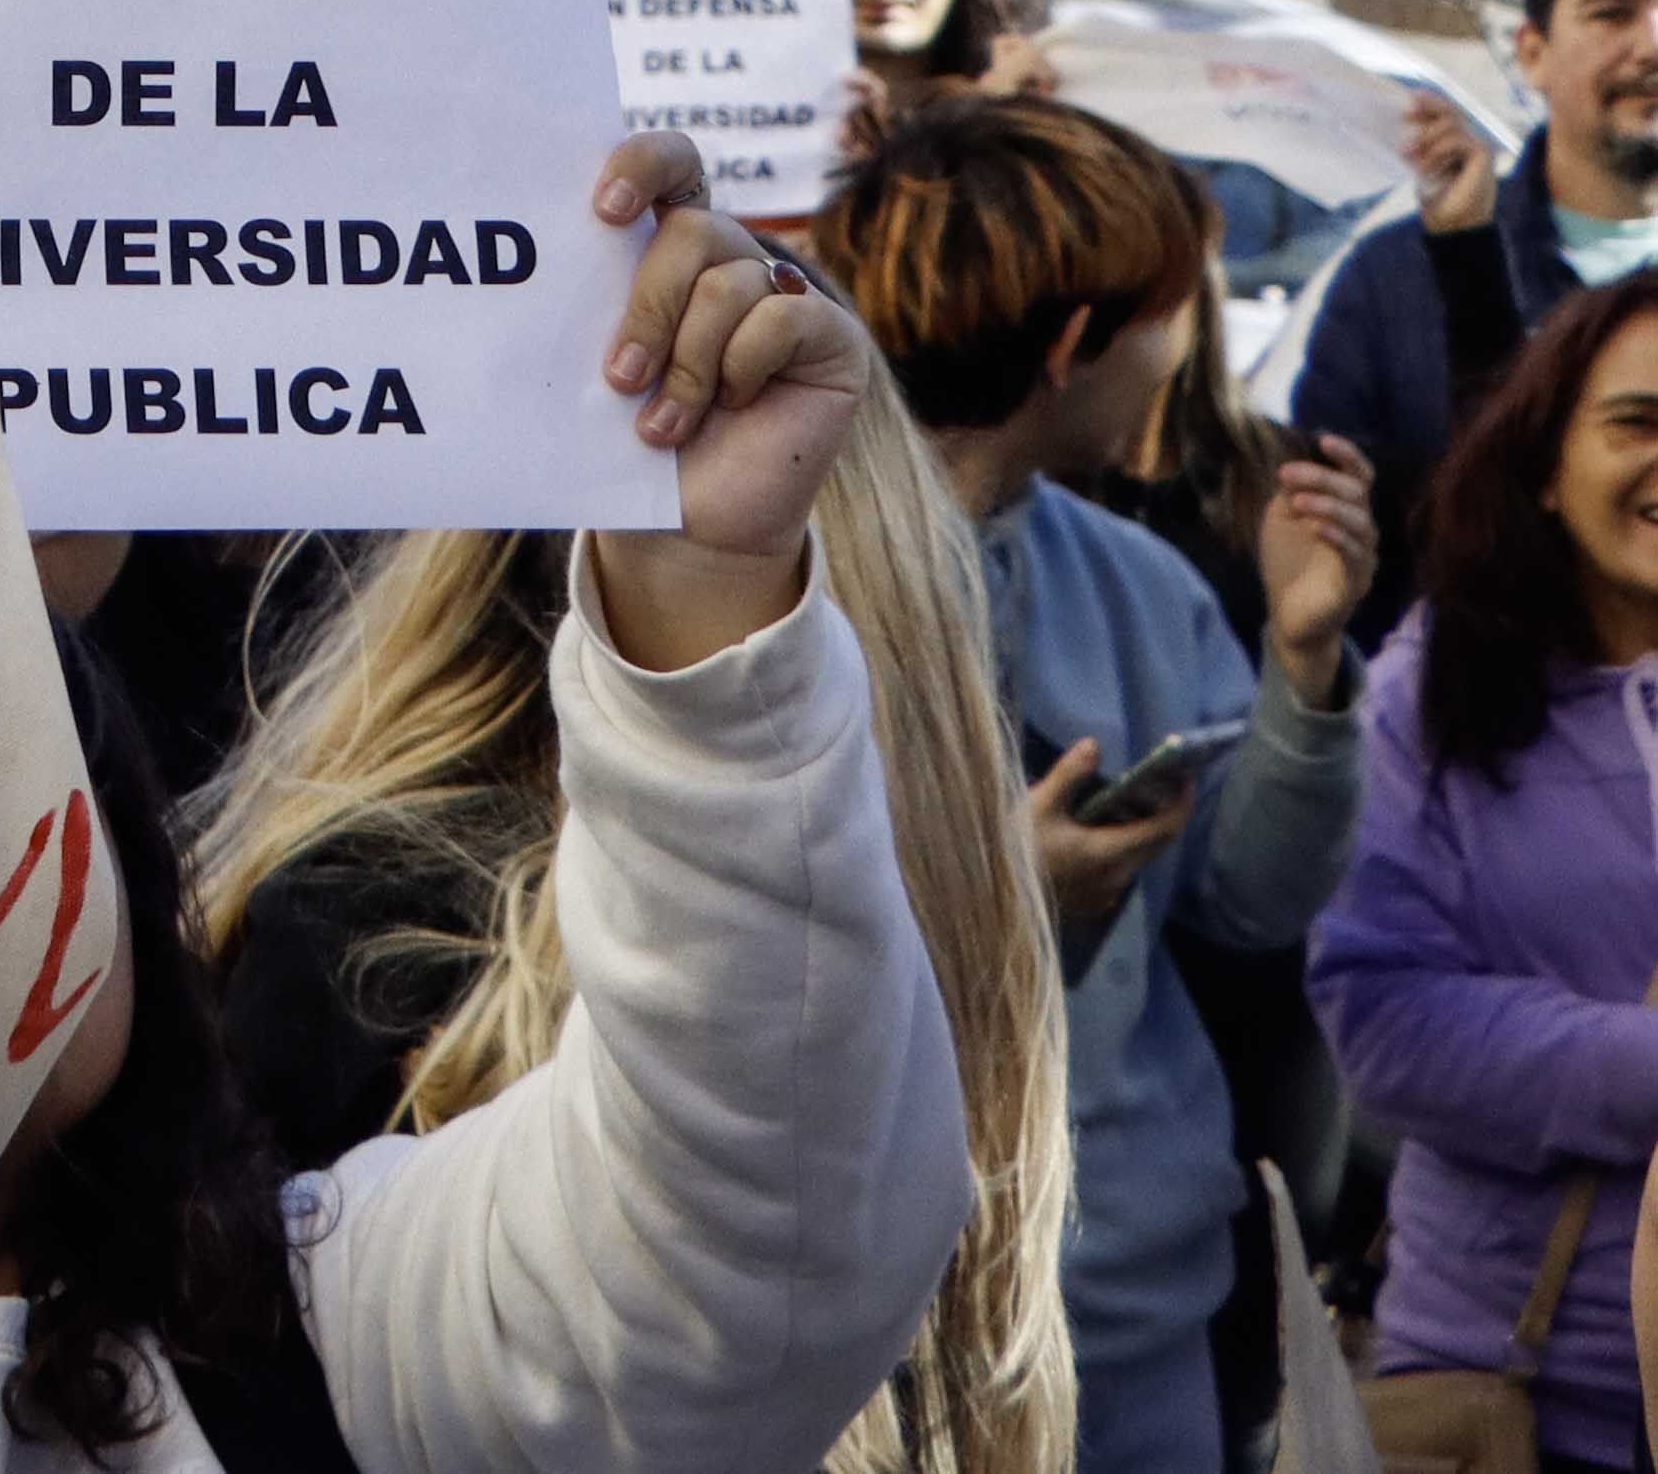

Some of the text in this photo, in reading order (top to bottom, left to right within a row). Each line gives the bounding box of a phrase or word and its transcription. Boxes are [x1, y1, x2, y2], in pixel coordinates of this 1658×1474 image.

[643, 49, 745, 73] DE LA
[49, 59, 339, 129] DE LA
[623, 104, 817, 128] IVERSIDAD
[713, 156, 775, 180] ICA
